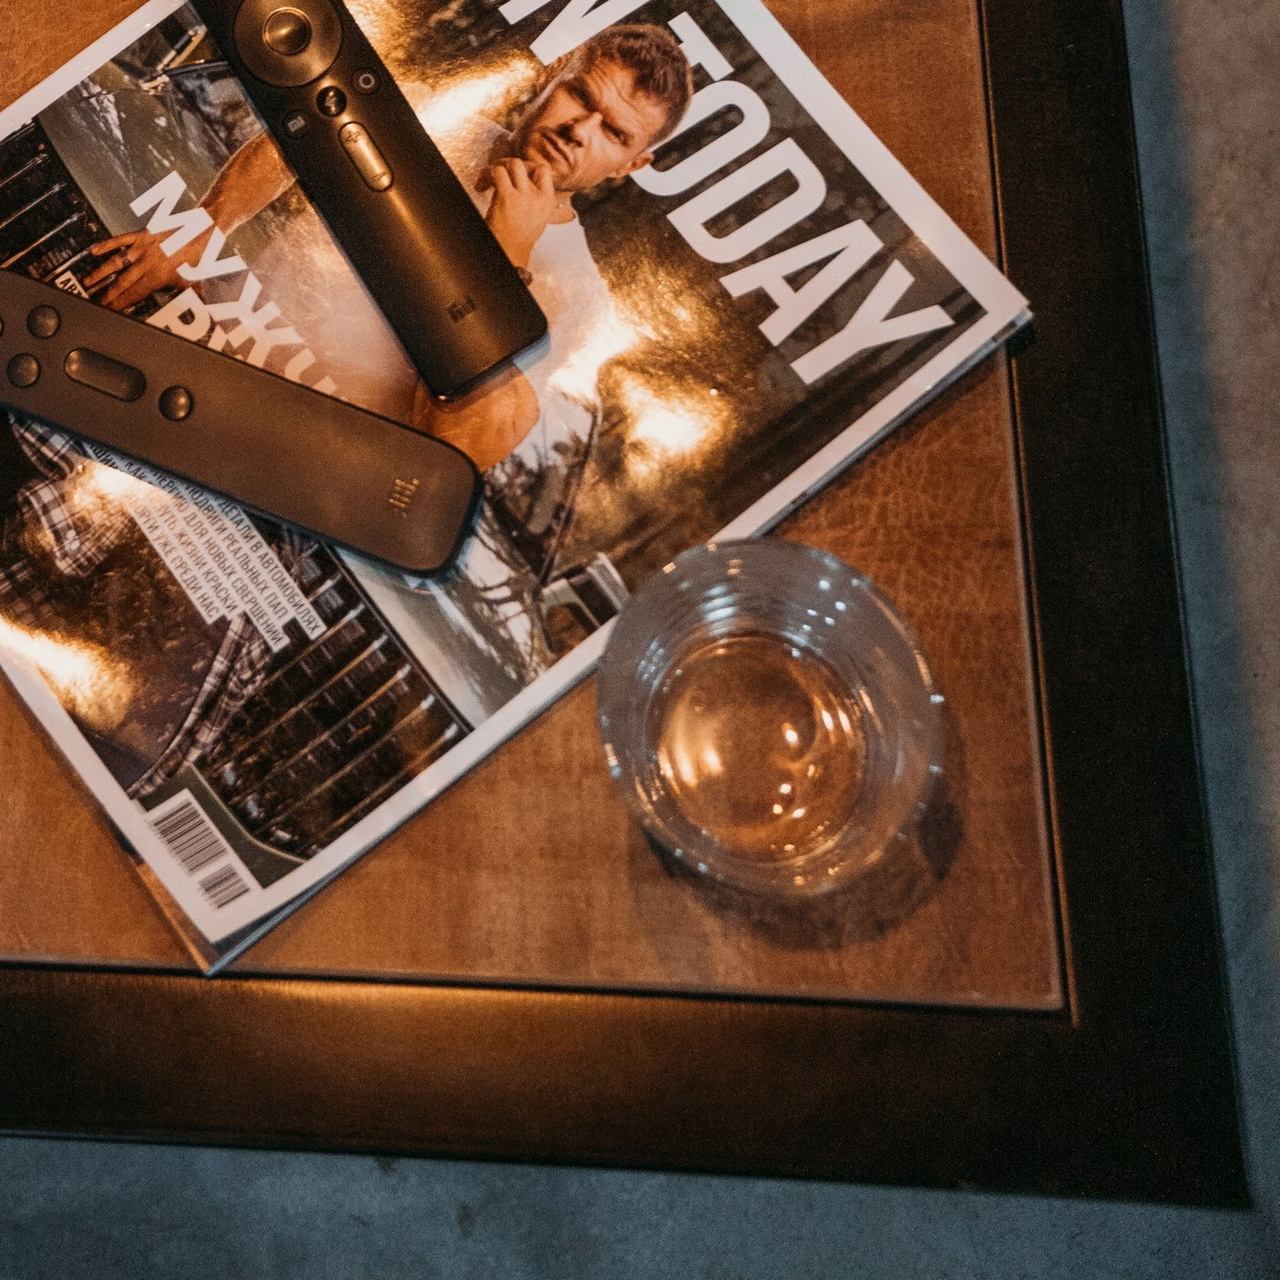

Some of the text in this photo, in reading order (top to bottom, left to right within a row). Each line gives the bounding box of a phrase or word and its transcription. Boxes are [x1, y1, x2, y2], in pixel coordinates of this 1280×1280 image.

[635, 12, 954, 386] TODAY
[153, 530, 222, 619] УЖЕ СРЕДИ НАС
[173, 526, 210, 569] ЖИЗНИ
[199, 566, 240, 613] КРАСКИ
[182, 511, 209, 540] ДЛЯ
[199, 536, 237, 579] НОВЫХ
[227, 575, 287, 647] СВЕРШЕНИЙ
[219, 532, 271, 595] РЕАЛЬНЫХ
[262, 592, 288, 620] ПАП
[256, 550, 321, 632] АВТОМОБИЛЯХ
